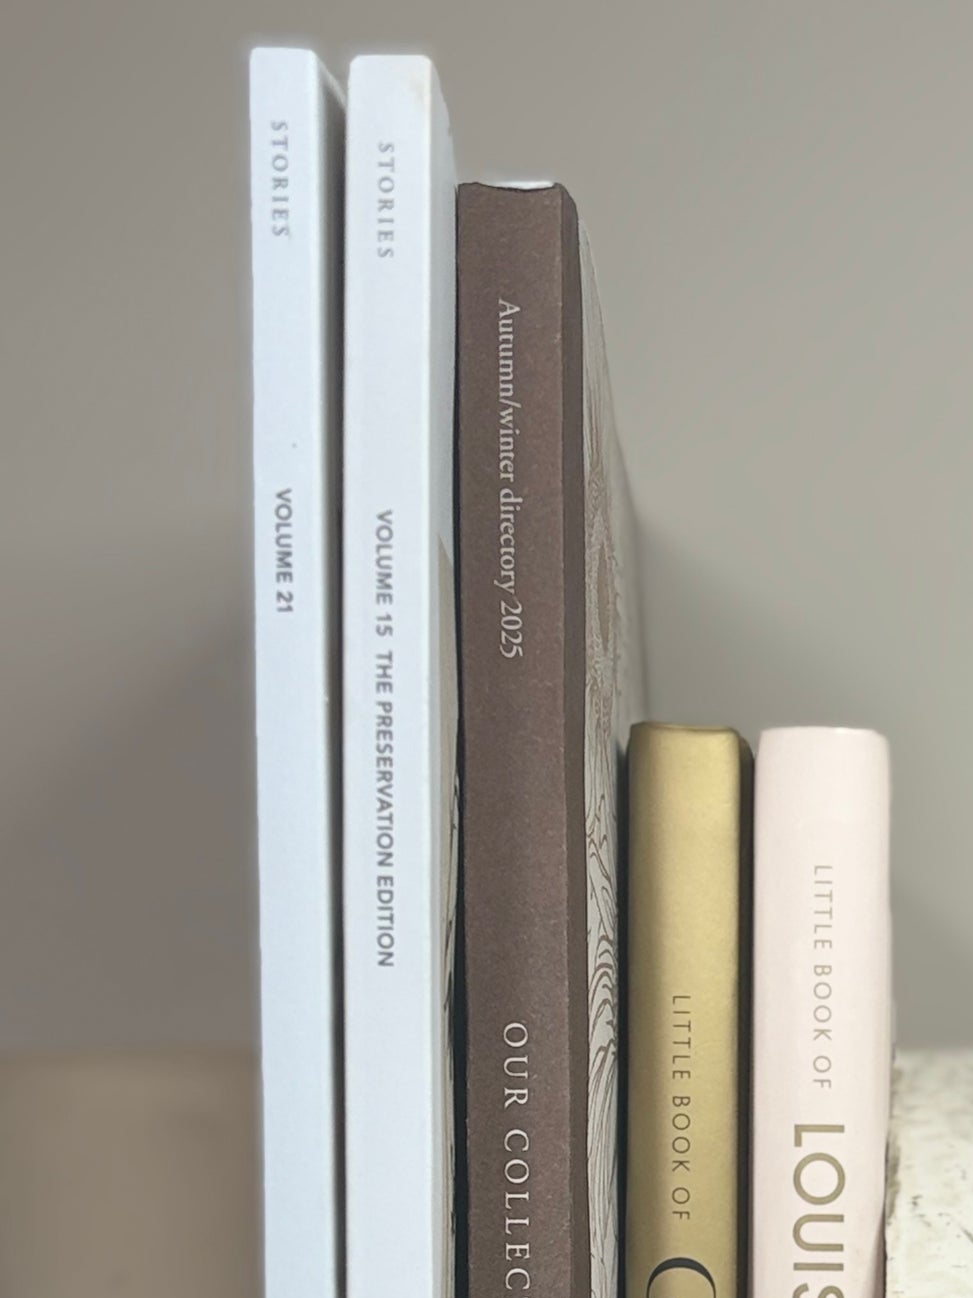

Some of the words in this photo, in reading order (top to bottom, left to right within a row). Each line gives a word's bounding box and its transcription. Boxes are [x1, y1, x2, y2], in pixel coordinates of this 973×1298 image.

[269, 120, 291, 238] STORIES
[376, 142, 396, 260] STORIES
[498, 298, 522, 484] Autumn/winter
[274, 488, 294, 585] VOLUME
[375, 509, 394, 606] VOLUME
[493, 487, 524, 594] directory
[275, 589, 294, 614] 21
[375, 612, 394, 637] 15
[499, 600, 524, 659] 2025
[375, 650, 394, 694] THE
[375, 700, 395, 868] PRESERVATION
[376, 874, 395, 967] EDITION
[813, 864, 834, 950] LITTLE
[671, 994, 692, 1081] LITTLE
[812, 964, 833, 1042] BOOK
[503, 1022, 530, 1109] OUR
[812, 1054, 833, 1089] OF
[670, 1094, 692, 1174] BOOK
[670, 1186, 691, 1221] OF
